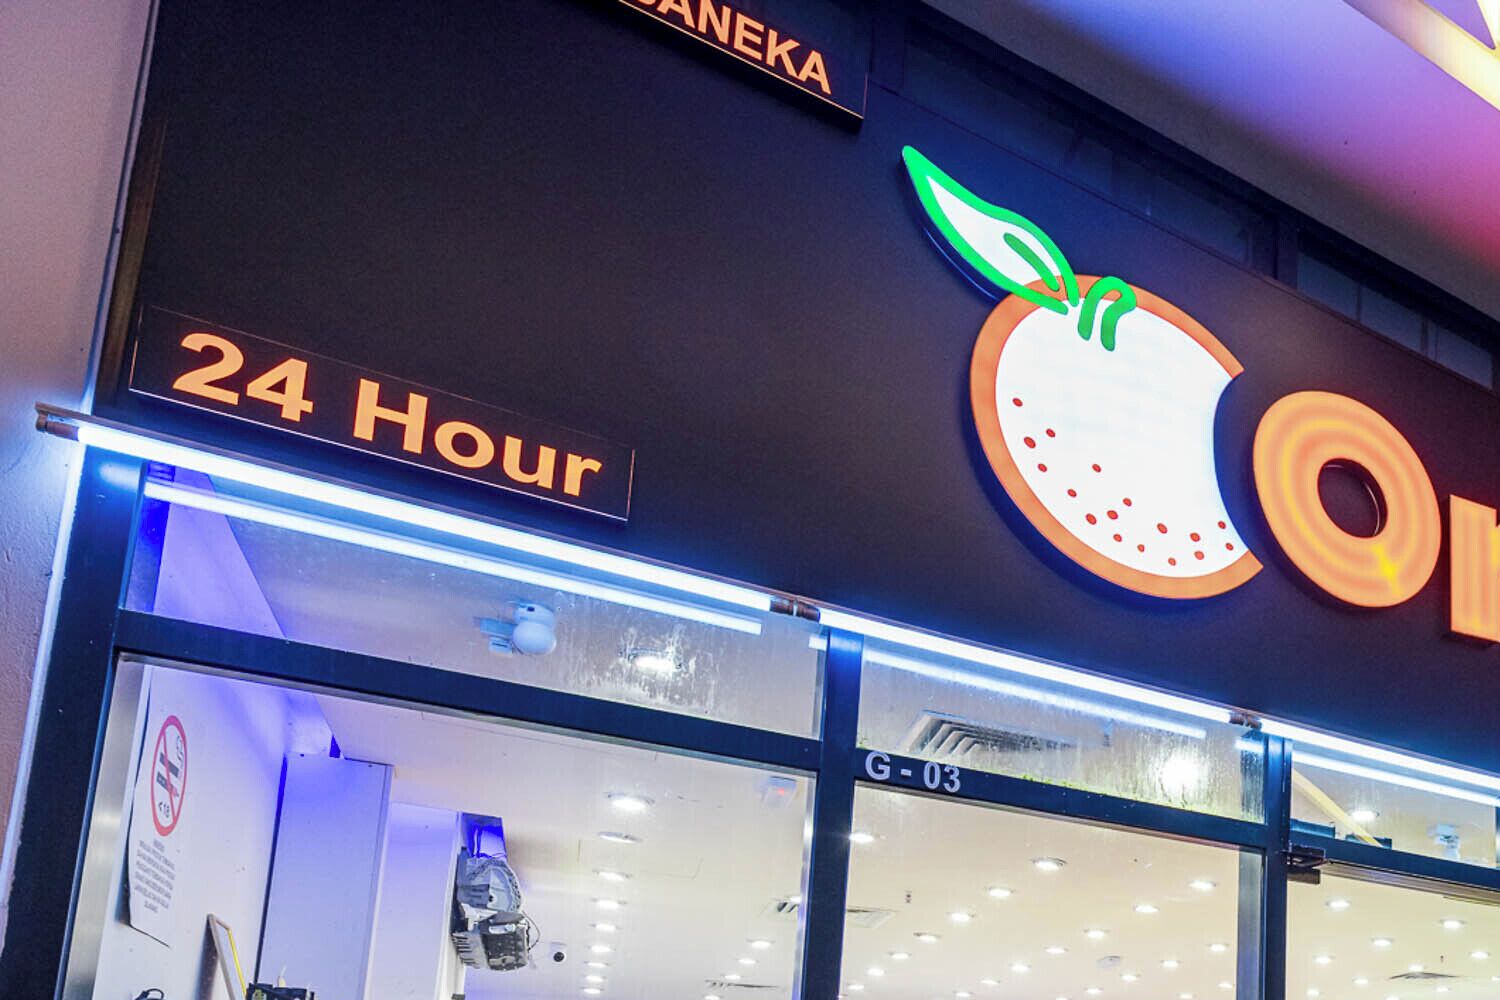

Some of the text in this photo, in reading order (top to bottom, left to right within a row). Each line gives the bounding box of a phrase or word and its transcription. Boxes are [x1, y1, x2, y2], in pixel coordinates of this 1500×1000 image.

[637, 0, 832, 94] ANEKA
[172, 332, 602, 496] 24 Hour
[865, 750, 891, 780] G
[923, 761, 961, 793] 03
